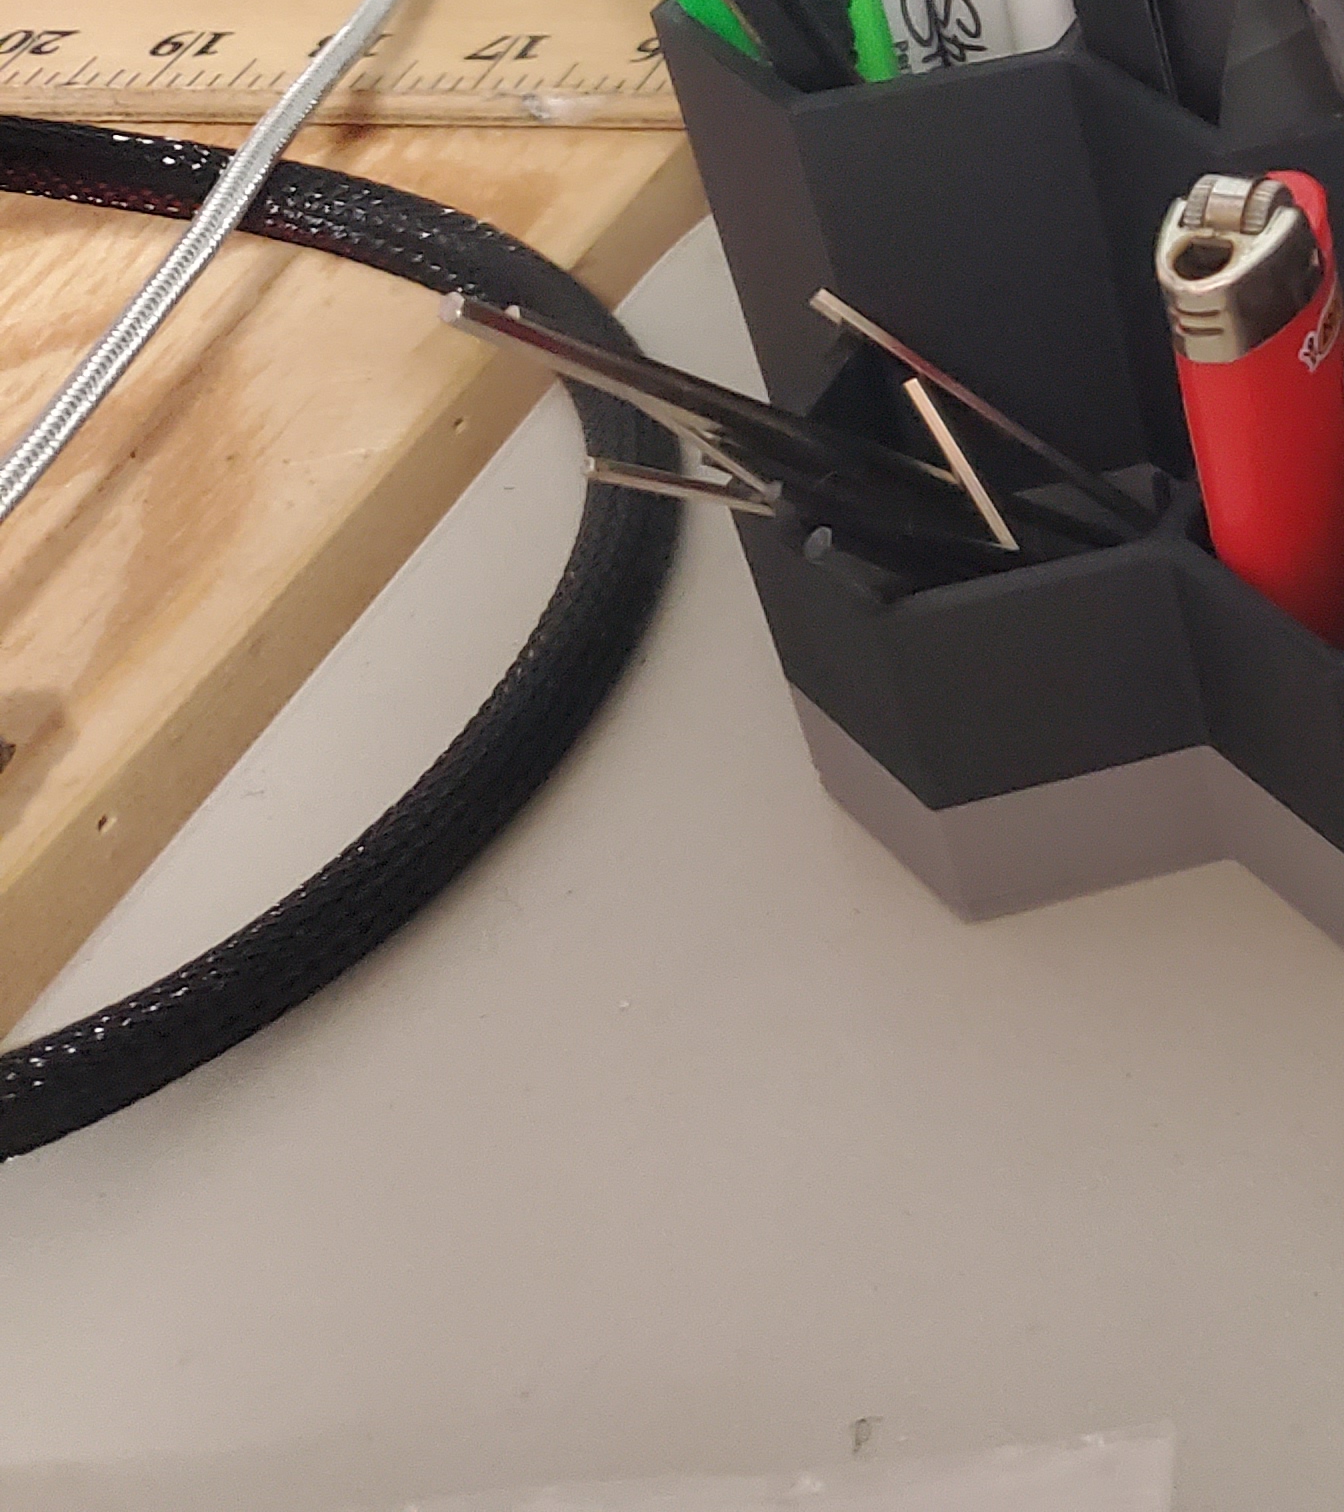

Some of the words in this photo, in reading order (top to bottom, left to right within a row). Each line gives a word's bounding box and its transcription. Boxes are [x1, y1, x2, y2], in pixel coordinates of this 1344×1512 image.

[0, 29, 80, 55] 20
[149, 30, 235, 57] 19
[463, 35, 551, 61] 17
